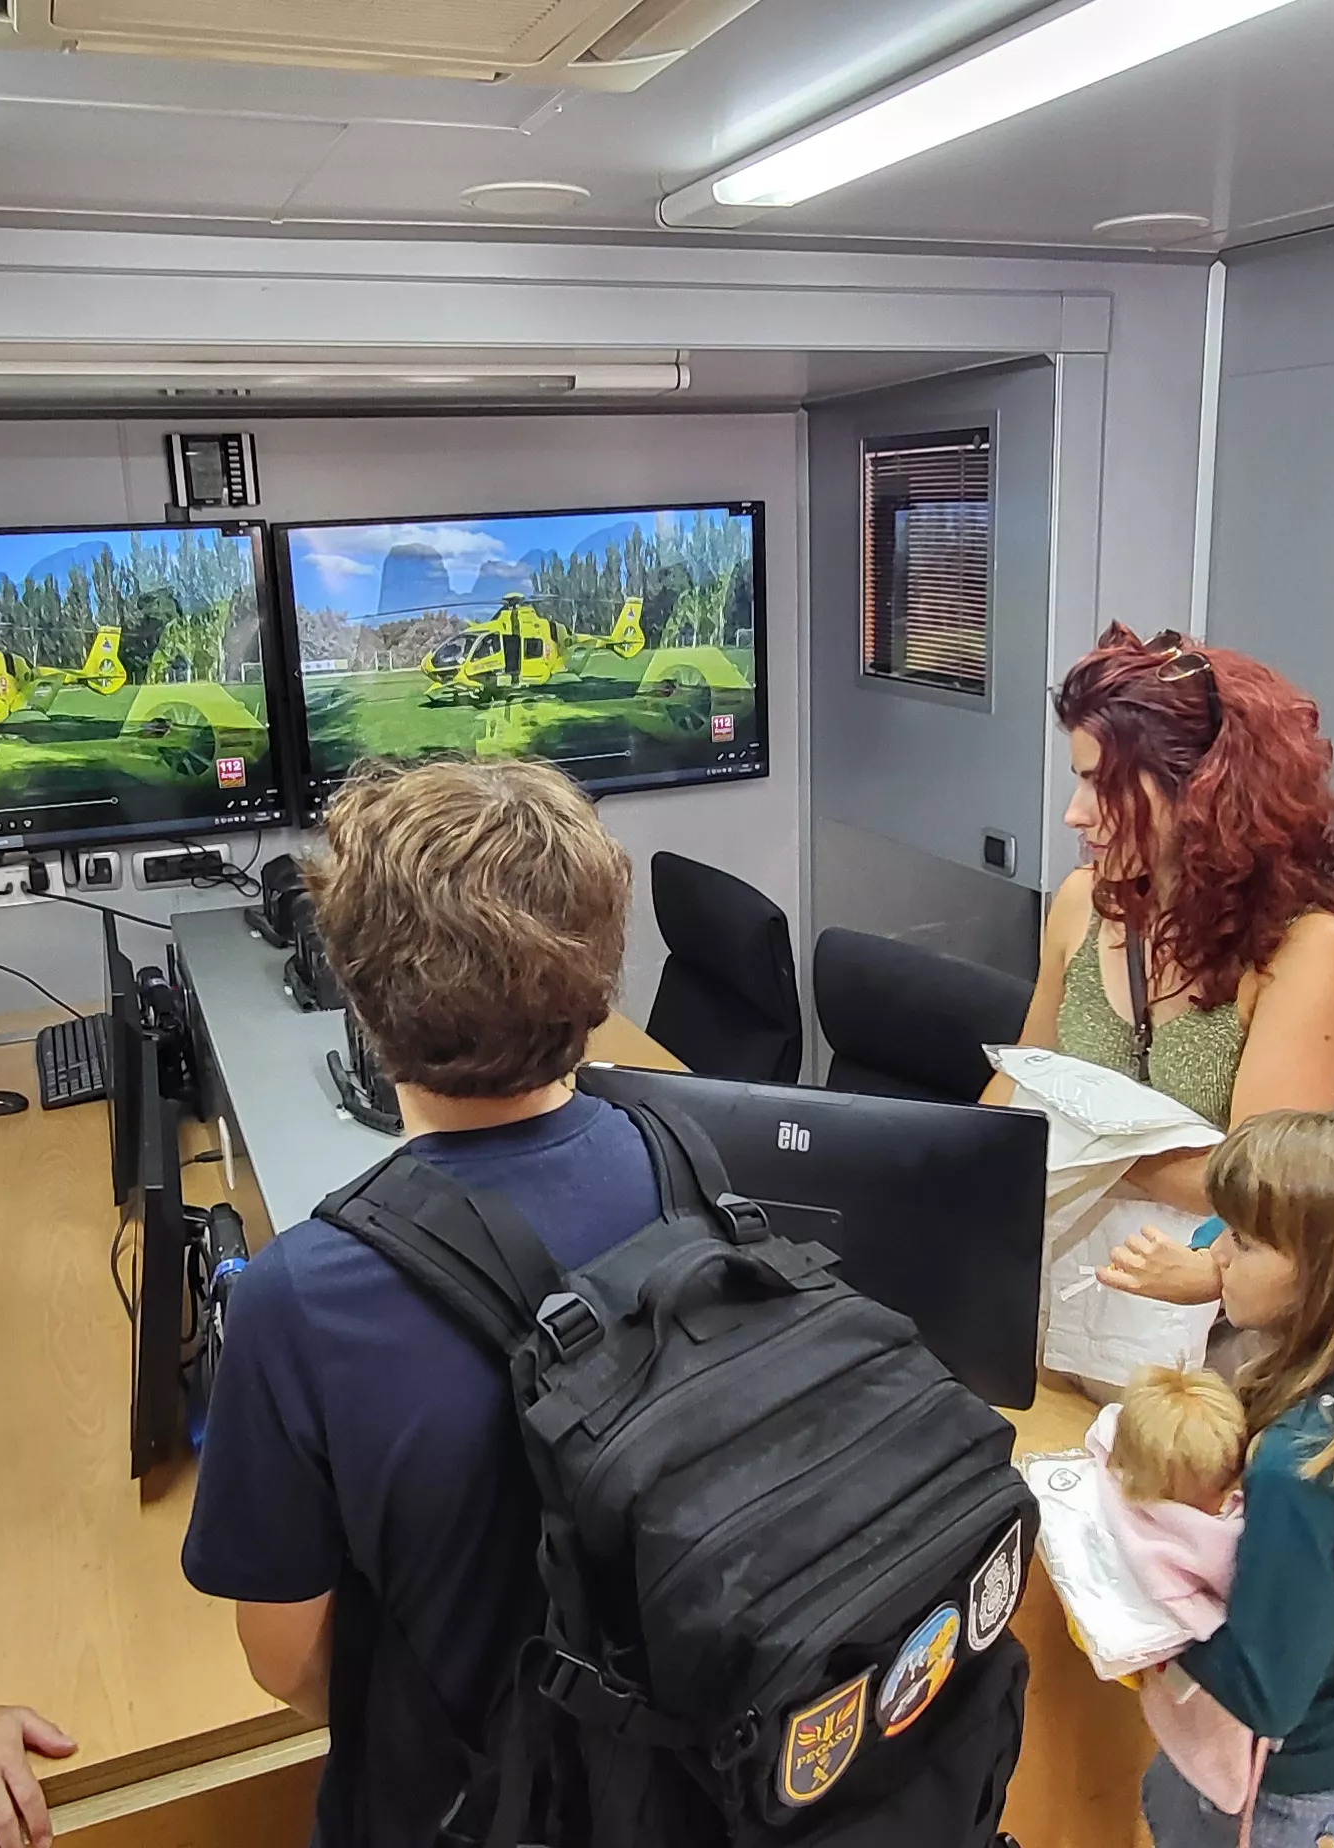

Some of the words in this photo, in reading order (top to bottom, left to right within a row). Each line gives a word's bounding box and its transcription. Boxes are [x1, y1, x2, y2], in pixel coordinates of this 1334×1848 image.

[714, 717, 732, 728] 112
[219, 760, 242, 772] 112
[796, 1724, 854, 1770] PEGASO
